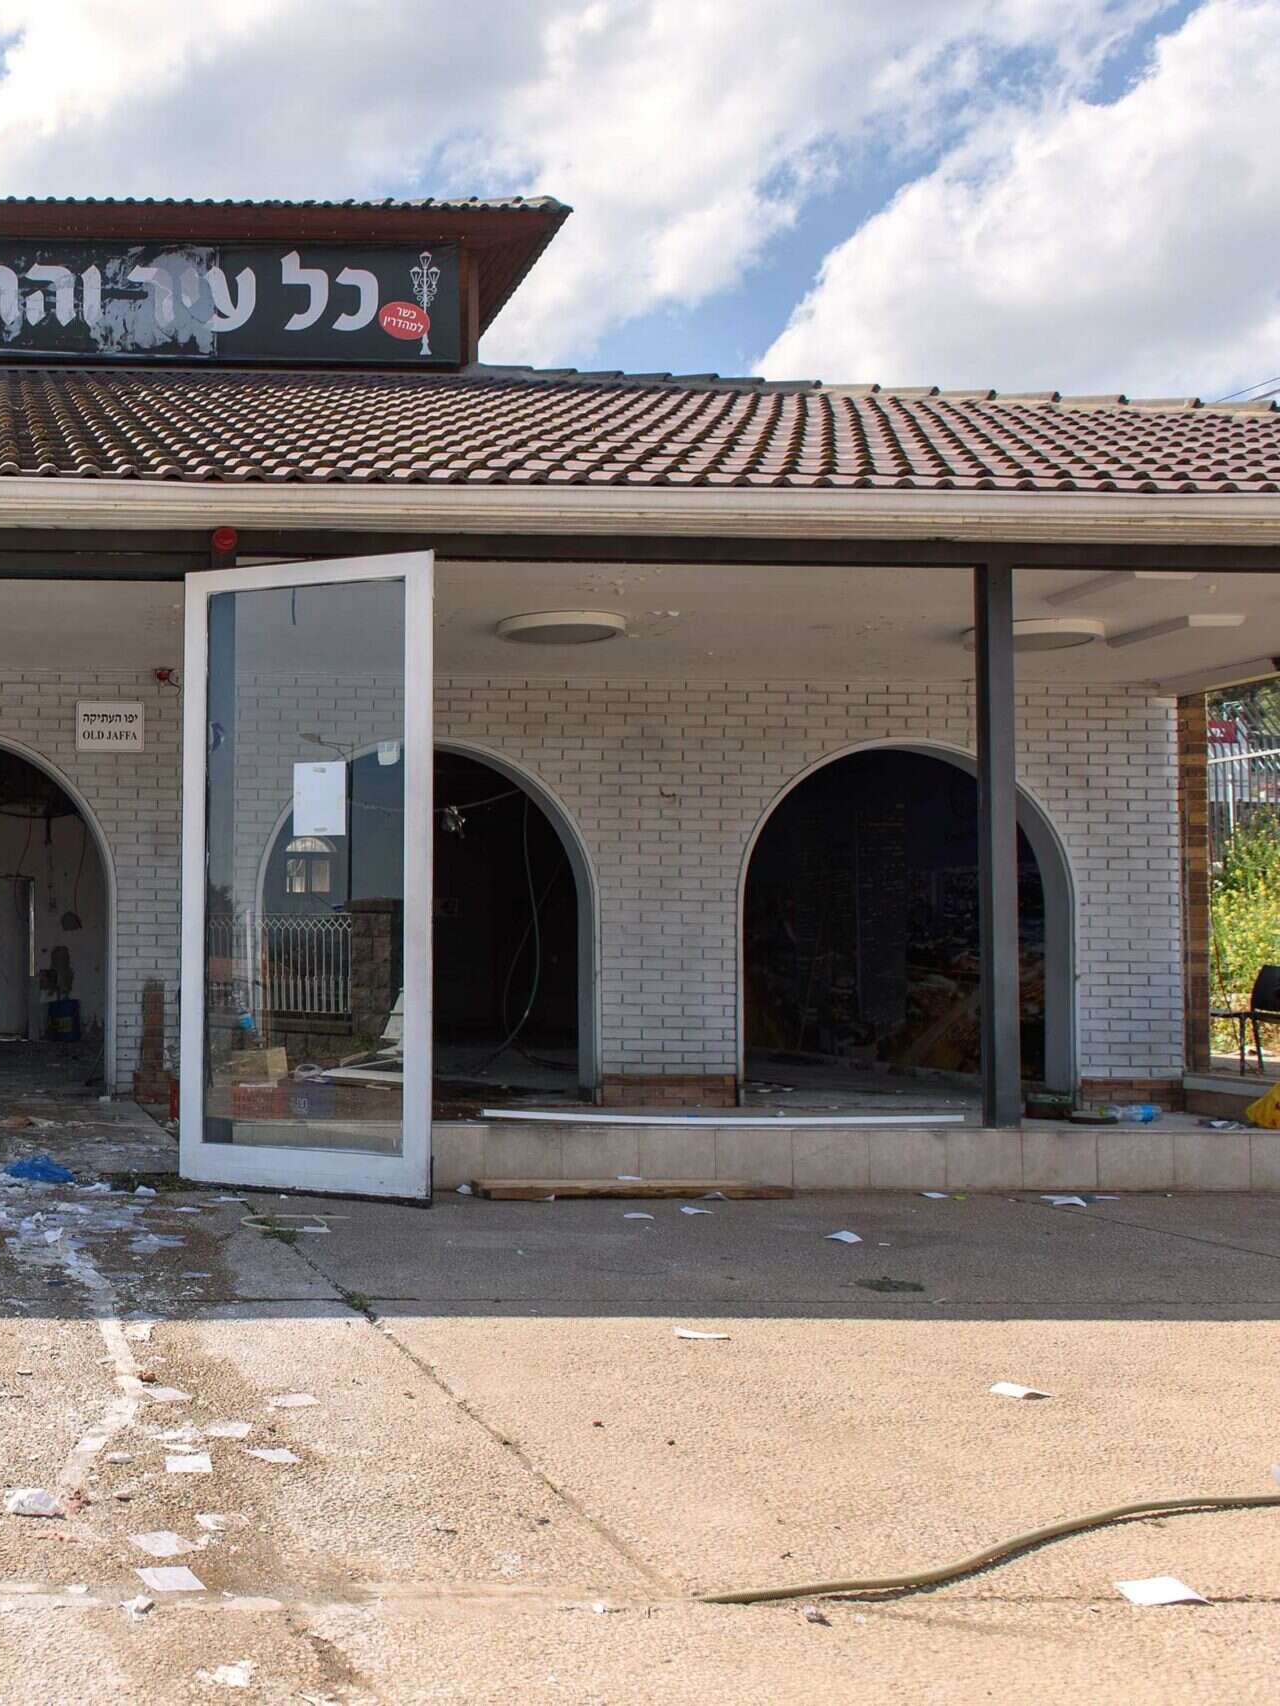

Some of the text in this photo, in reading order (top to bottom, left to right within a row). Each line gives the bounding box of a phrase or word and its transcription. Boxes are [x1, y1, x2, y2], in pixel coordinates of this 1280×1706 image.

[280, 249, 380, 332] כל
[396, 306, 417, 319] כשר
[383, 316, 424, 333] למהדרין
[82, 713, 138, 725] יפו העתיקה
[82, 730, 137, 740] OLD JAFFA
